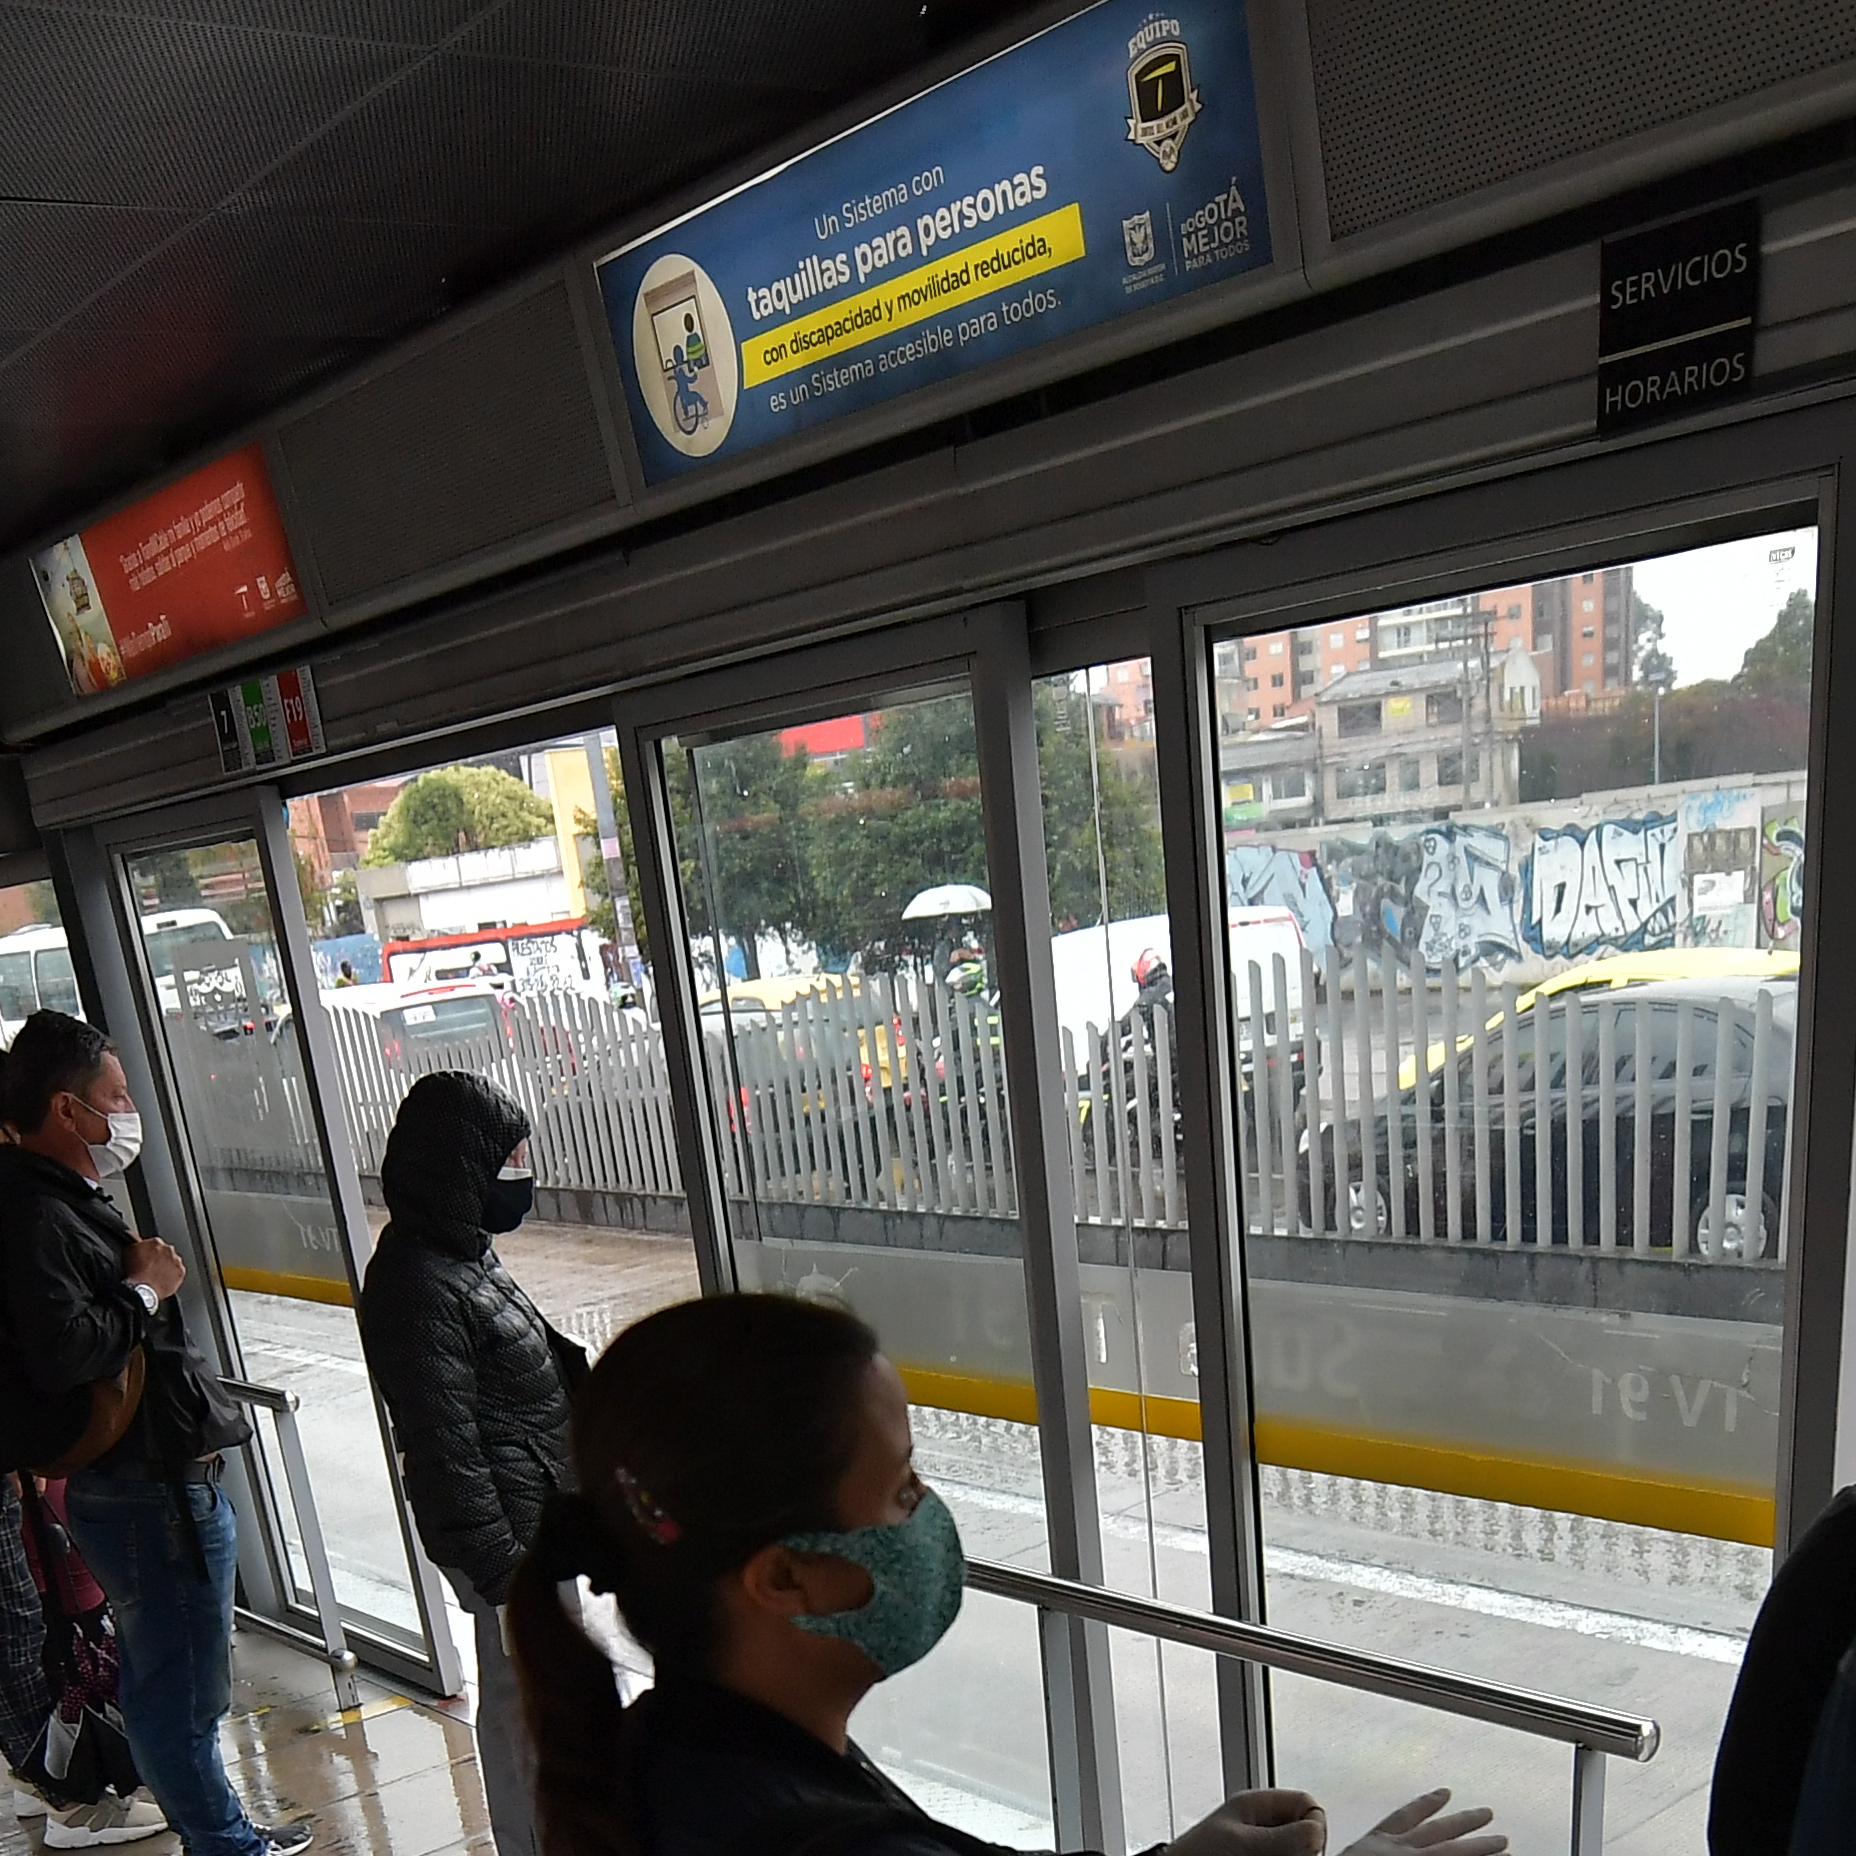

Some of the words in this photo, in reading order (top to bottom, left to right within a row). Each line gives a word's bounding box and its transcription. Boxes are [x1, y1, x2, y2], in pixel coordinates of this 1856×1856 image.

[1128, 19, 1180, 59] EQUIPO
[815, 214, 840, 241] Un
[842, 183, 909, 228] Sistema
[911, 165, 945, 197] con
[1180, 176, 1245, 235] BOGOTÁ
[747, 251, 851, 321] taquillas
[854, 225, 913, 284] para
[916, 164, 1047, 257] personas
[1182, 216, 1248, 258] MEJOR
[1186, 253, 1212, 271] PARA
[1214, 240, 1250, 260] TODOS
[763, 342, 788, 366] con
[789, 299, 883, 355] discapacidad
[884, 302, 895, 323] y
[896, 262, 972, 313] movilidad
[973, 234, 1053, 282] reducida,
[1610, 242, 1748, 310] SERVICIOS
[770, 391, 787, 413] es
[790, 382, 810, 405] un
[812, 357, 875, 397] Sistema
[877, 326, 954, 372] accesible
[958, 311, 998, 347] para
[1001, 287, 1062, 326] todos.
[1605, 352, 1746, 414] HORARIOS
[220, 709, 229, 733] 7
[246, 703, 267, 728] B50
[284, 696, 304, 723] F19
